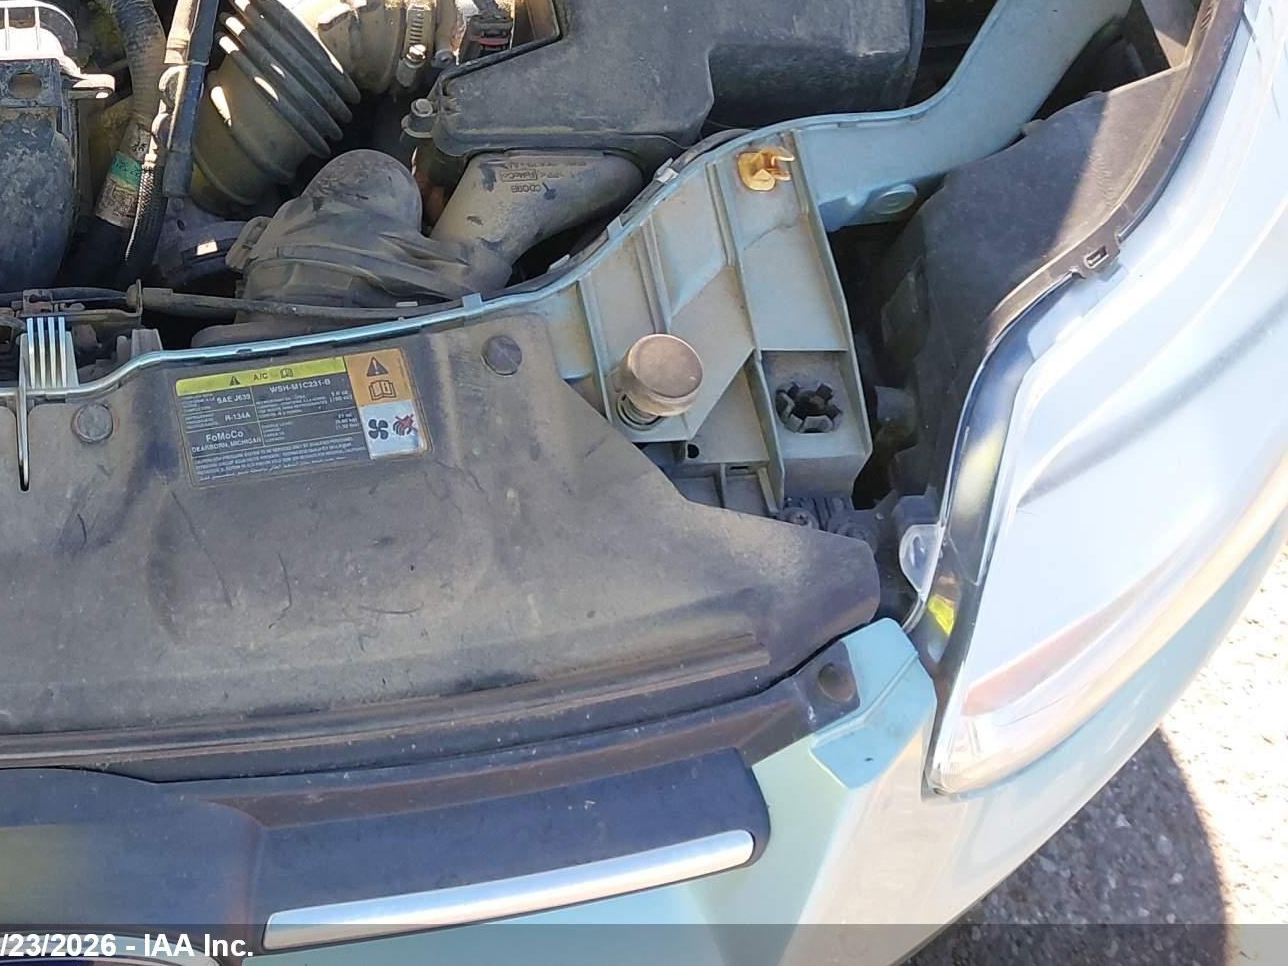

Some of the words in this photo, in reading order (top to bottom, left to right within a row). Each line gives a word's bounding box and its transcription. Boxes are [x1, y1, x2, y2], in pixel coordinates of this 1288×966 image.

[253, 374, 268, 382] A/C
[225, 412, 251, 421] R-134A
[206, 431, 244, 442] FoMoCo
[230, 437, 262, 447] MICHIGAN
